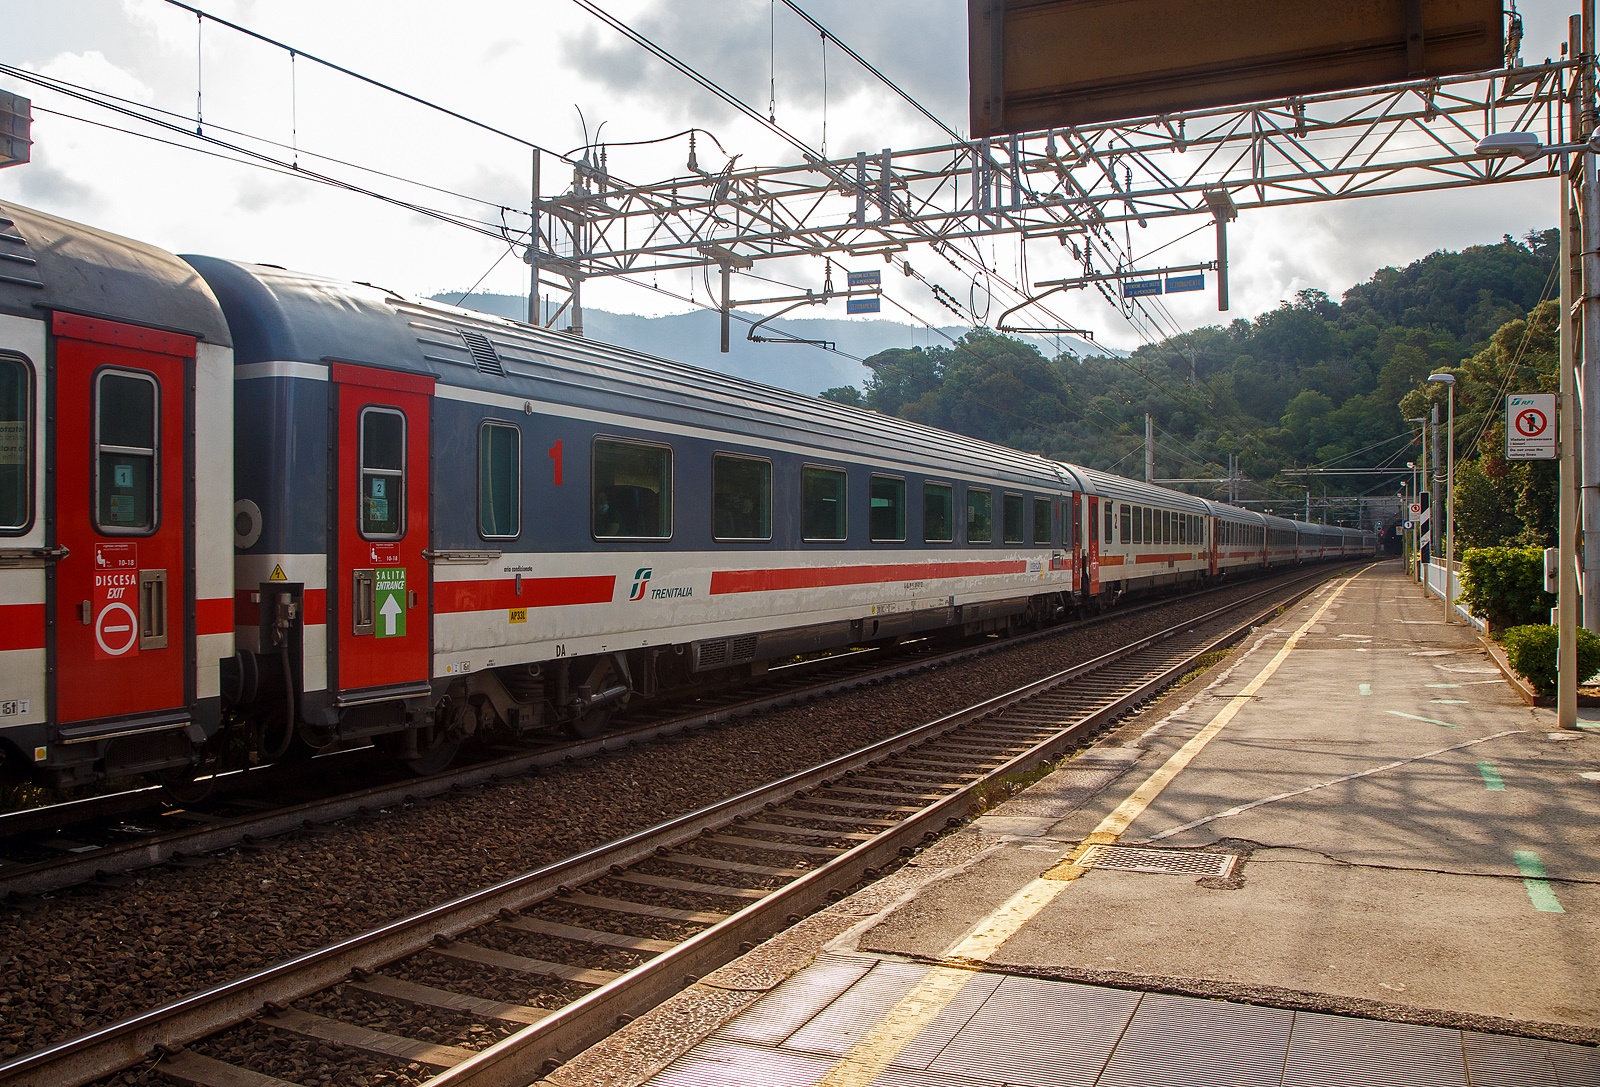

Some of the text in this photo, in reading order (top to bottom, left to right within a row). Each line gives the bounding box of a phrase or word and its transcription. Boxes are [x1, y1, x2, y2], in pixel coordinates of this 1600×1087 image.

[549, 440, 563, 486] 1
[120, 472, 126, 483] 1
[377, 483, 382, 493] 2
[95, 574, 137, 587] DISCESA
[376, 570, 405, 580] SALITA
[375, 580, 405, 591] ENTRANCE
[107, 587, 126, 599] EXIT
[651, 586, 693, 600] TRENITALIA
[510, 610, 526, 621] AP33L
[556, 643, 566, 658] DA
